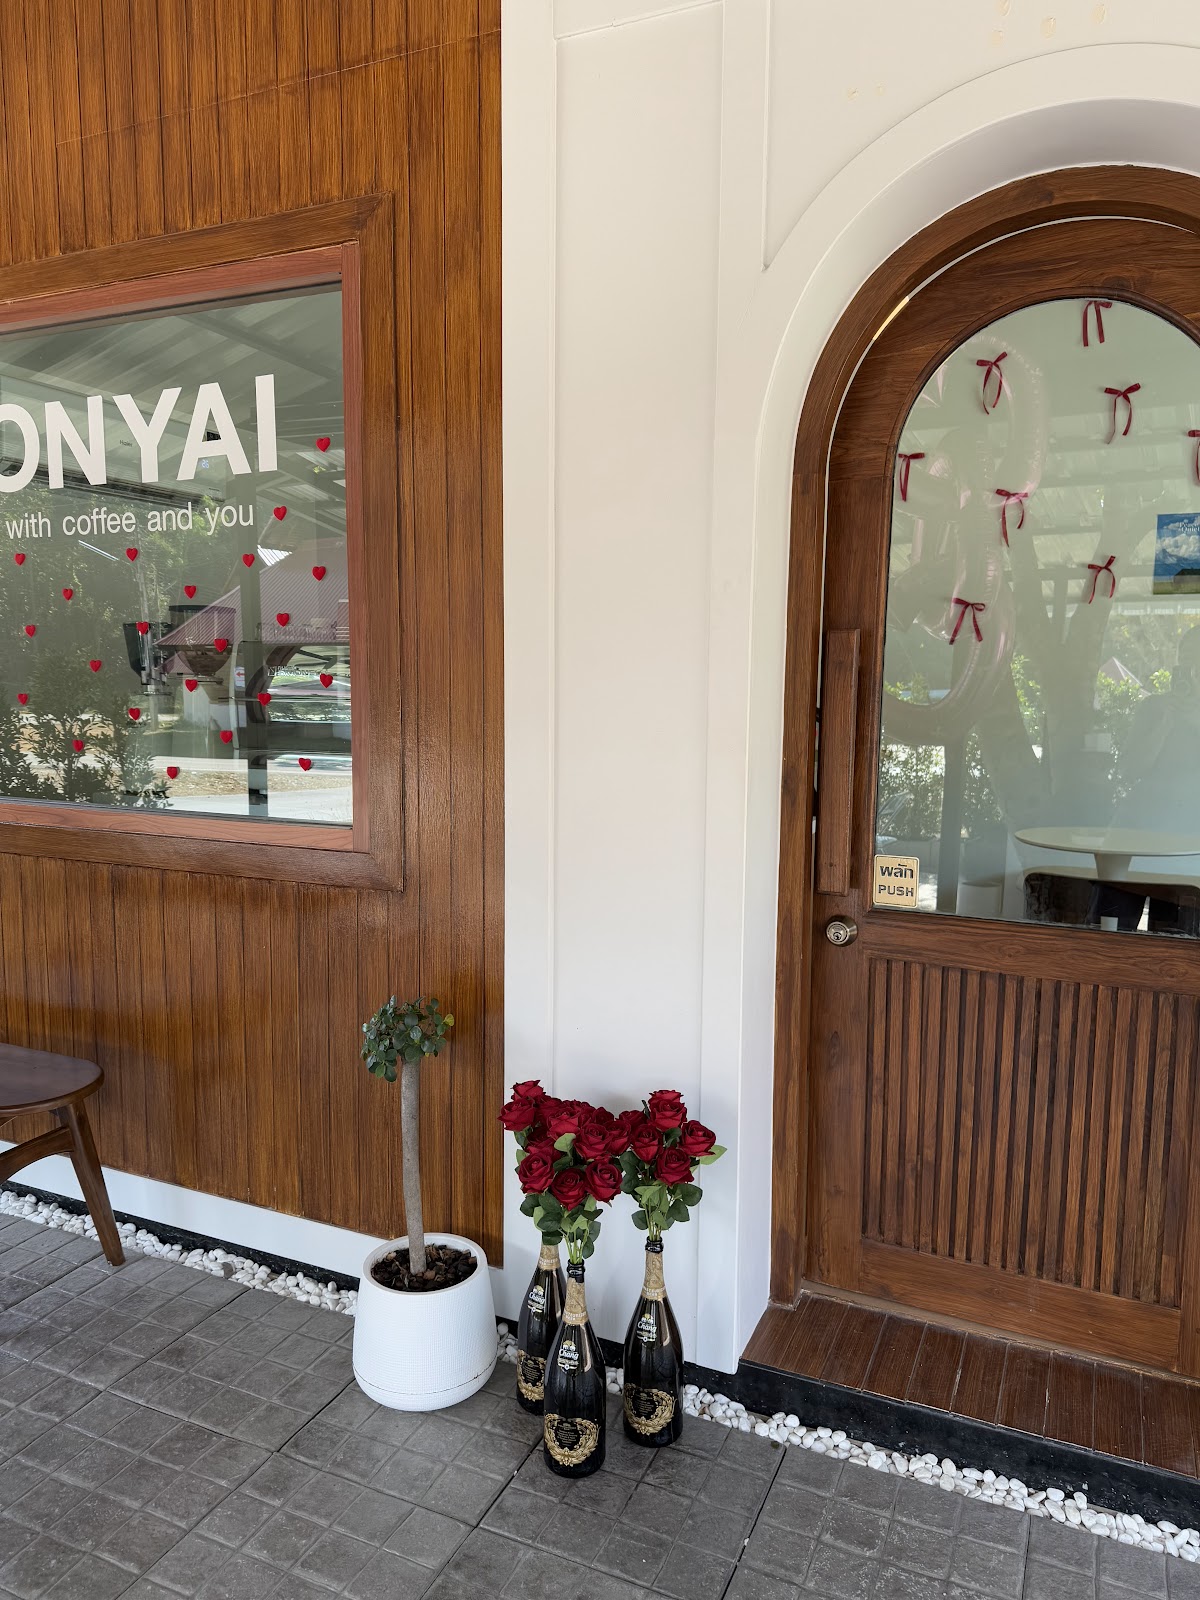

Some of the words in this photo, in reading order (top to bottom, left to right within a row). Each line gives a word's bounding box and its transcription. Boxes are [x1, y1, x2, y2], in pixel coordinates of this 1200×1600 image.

[0, 373, 278, 493] ONYAI
[6, 511, 52, 539] with
[62, 507, 137, 536] coffee
[147, 502, 193, 532] and
[205, 504, 254, 536] you
[879, 863, 914, 879] ผลัก
[878, 884, 915, 897] PUSH
[528, 1291, 545, 1305] Chang
[637, 1321, 657, 1333] Chang
[558, 1348, 579, 1360] Chang
